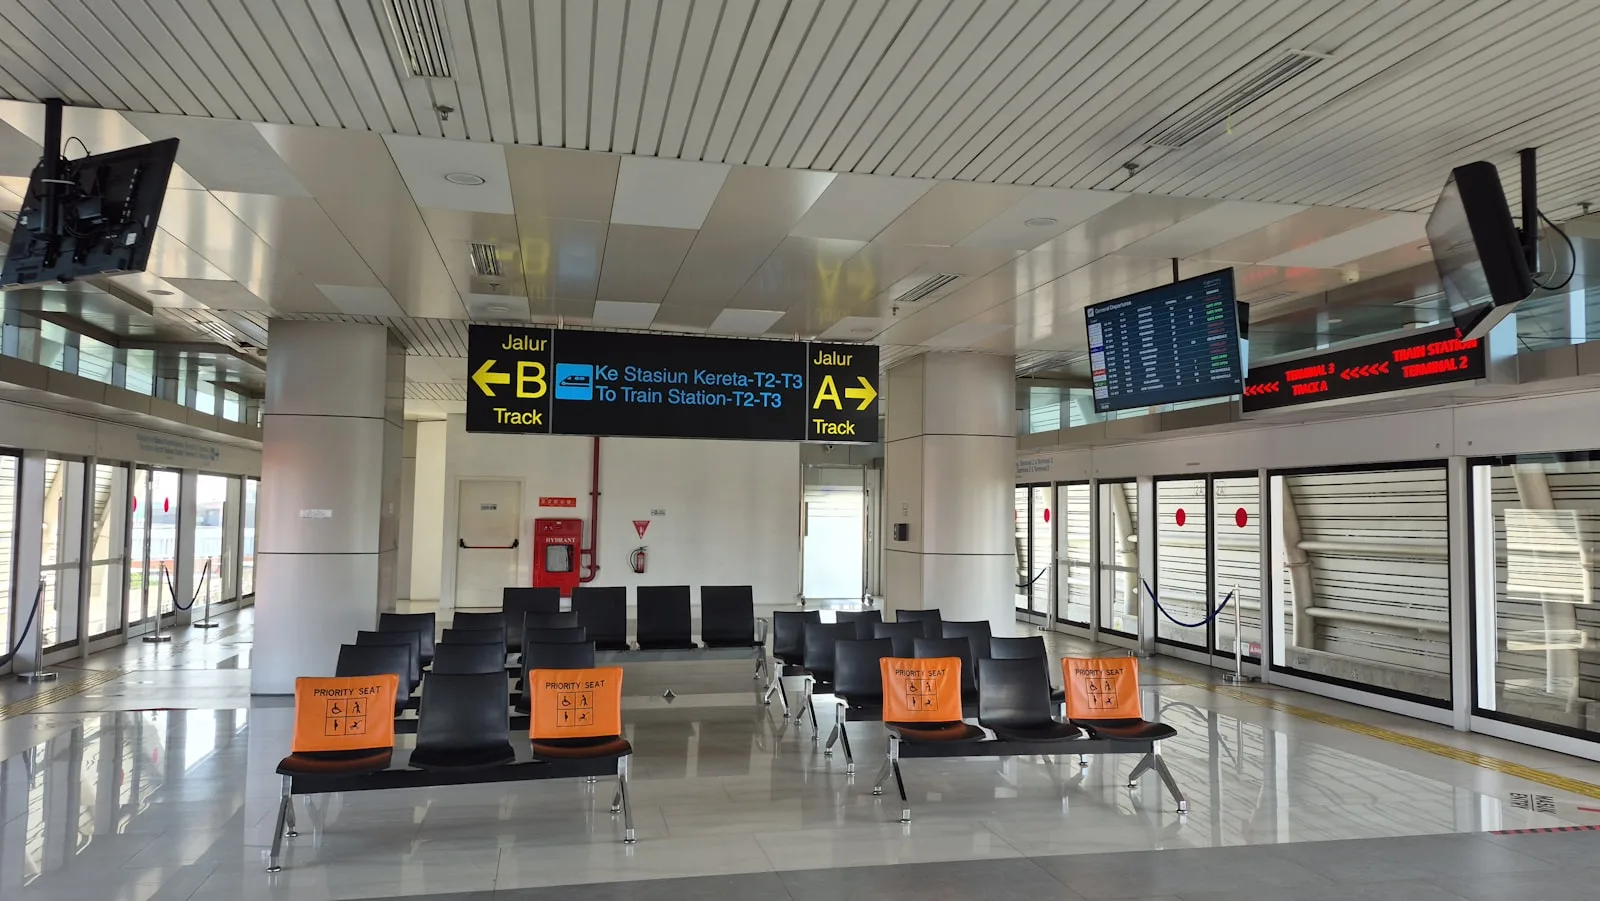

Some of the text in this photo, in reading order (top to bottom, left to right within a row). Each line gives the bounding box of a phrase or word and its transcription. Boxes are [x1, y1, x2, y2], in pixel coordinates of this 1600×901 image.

[1094, 306, 1109, 315] General
[1109, 301, 1132, 312] Departures
[502, 334, 548, 352] Jalur
[813, 350, 853, 366] Jalur
[1392, 345, 1426, 363] TRAIN
[1285, 363, 1335, 382] TERMINAL 3
[1402, 356, 1468, 378] TERMINAL 2
[516, 360, 548, 399] B
[595, 365, 803, 389] Ke Stasiun Kereta-T2-T3
[595, 385, 782, 409] To Train Station-T2-T3
[812, 374, 843, 410] A
[1292, 380, 1328, 396] TRACK A
[493, 407, 543, 425] Track
[812, 418, 855, 435] Track
[895, 669, 946, 677] PRIORITY SEAT
[1075, 668, 1124, 676] PRIORITY SEAT
[313, 685, 382, 697] PRIORITY SEAT
[545, 680, 605, 690] PRIORITY SEAT
[1510, 793, 1529, 810] ENTRY
[1535, 795, 1557, 815] MASUK
